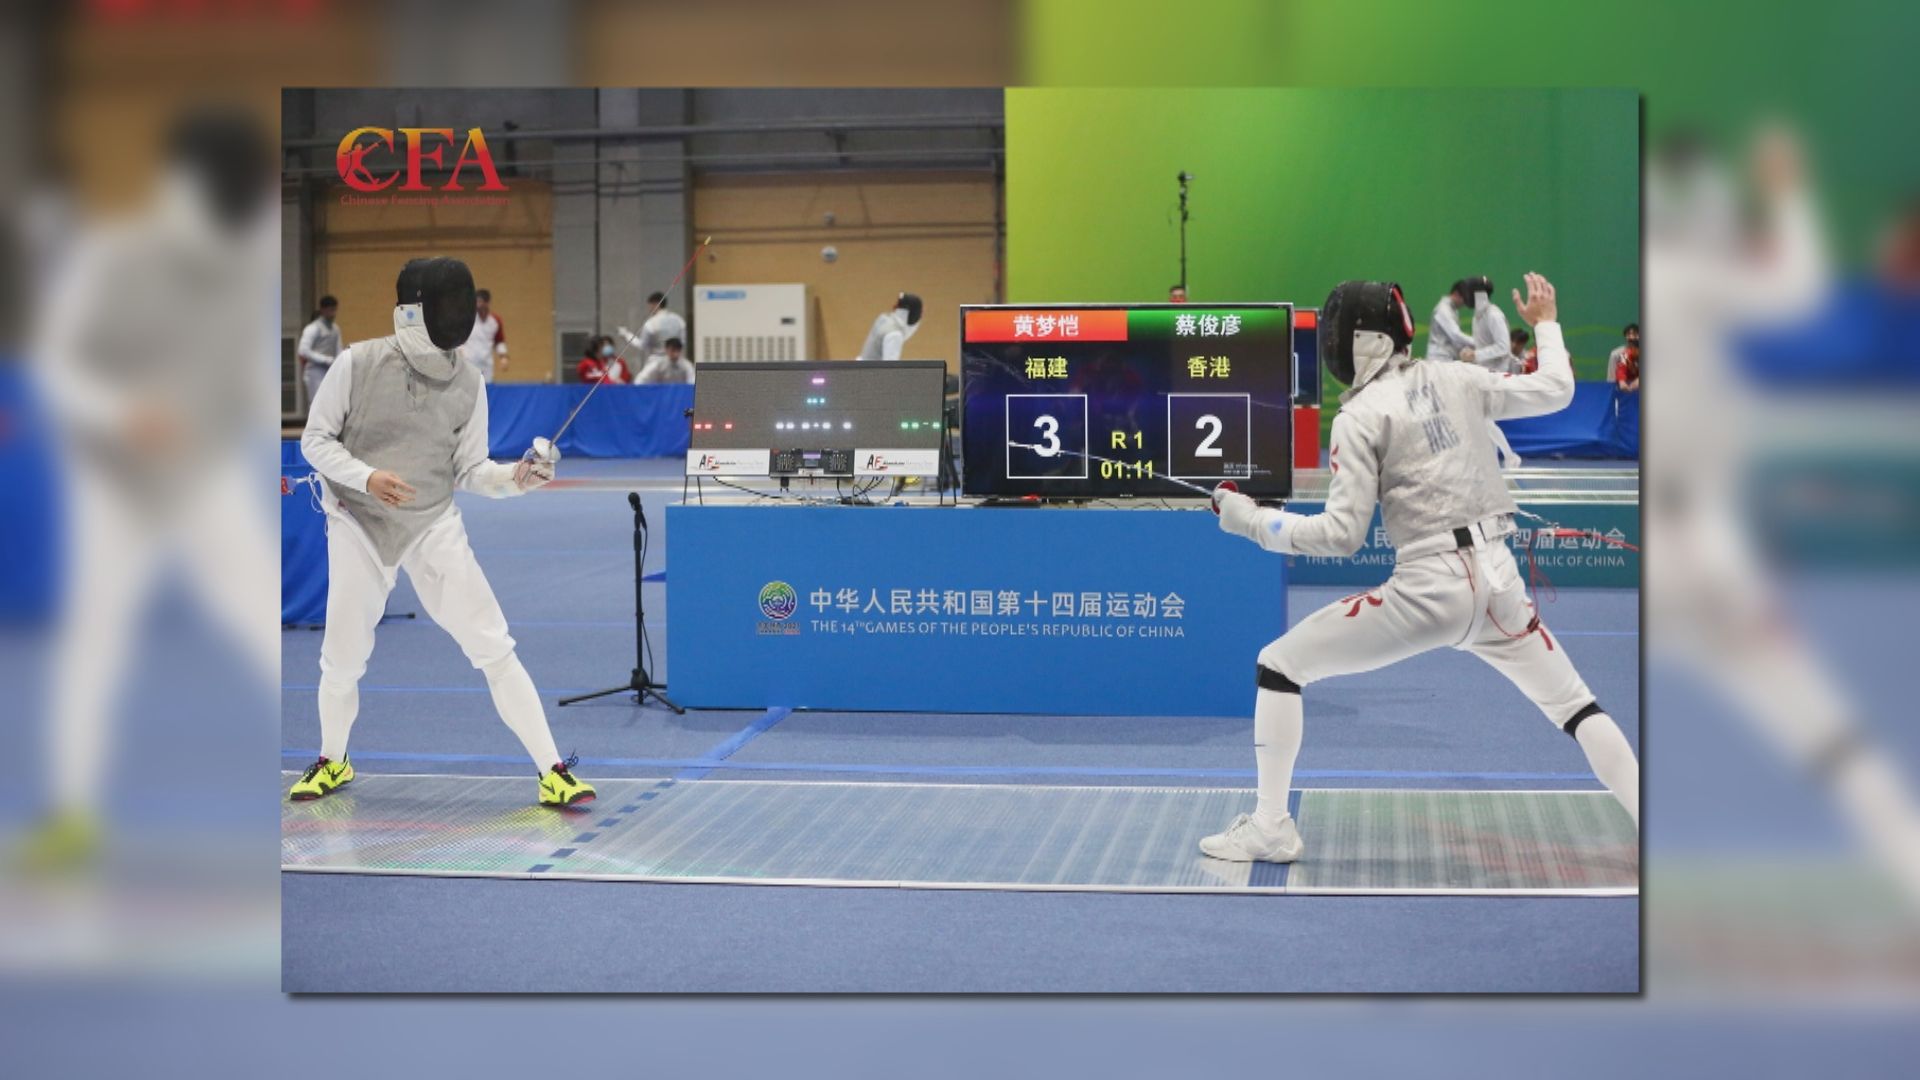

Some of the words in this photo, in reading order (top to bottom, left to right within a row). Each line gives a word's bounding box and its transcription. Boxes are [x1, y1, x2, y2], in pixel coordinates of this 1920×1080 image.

[1013, 314, 1079, 337] 黄梦恺
[1175, 314, 1242, 337] 蔡俊彦
[1025, 356, 1069, 379] 福建
[1187, 356, 1231, 379] 香港
[1033, 414, 1061, 458] 3
[1111, 431, 1127, 449] R
[1134, 431, 1143, 449] 1
[1194, 414, 1223, 458] 2
[1100, 460, 1153, 479] 01:11
[1306, 554, 1328, 566] THE
[1351, 553, 1395, 566] GAMES
[1567, 555, 1582, 567] OF
[1586, 555, 1625, 567] CHINA
[810, 587, 1185, 620] 中华人民共和国第十四届运动会
[811, 620, 838, 633] THE
[919, 622, 937, 634] OF
[941, 622, 968, 635] THE
[971, 622, 1038, 636] PEOPLE'S
[1042, 623, 1113, 638] REPUBLIC
[1116, 625, 1135, 637] OF
[1138, 625, 1185, 638] CHINA
